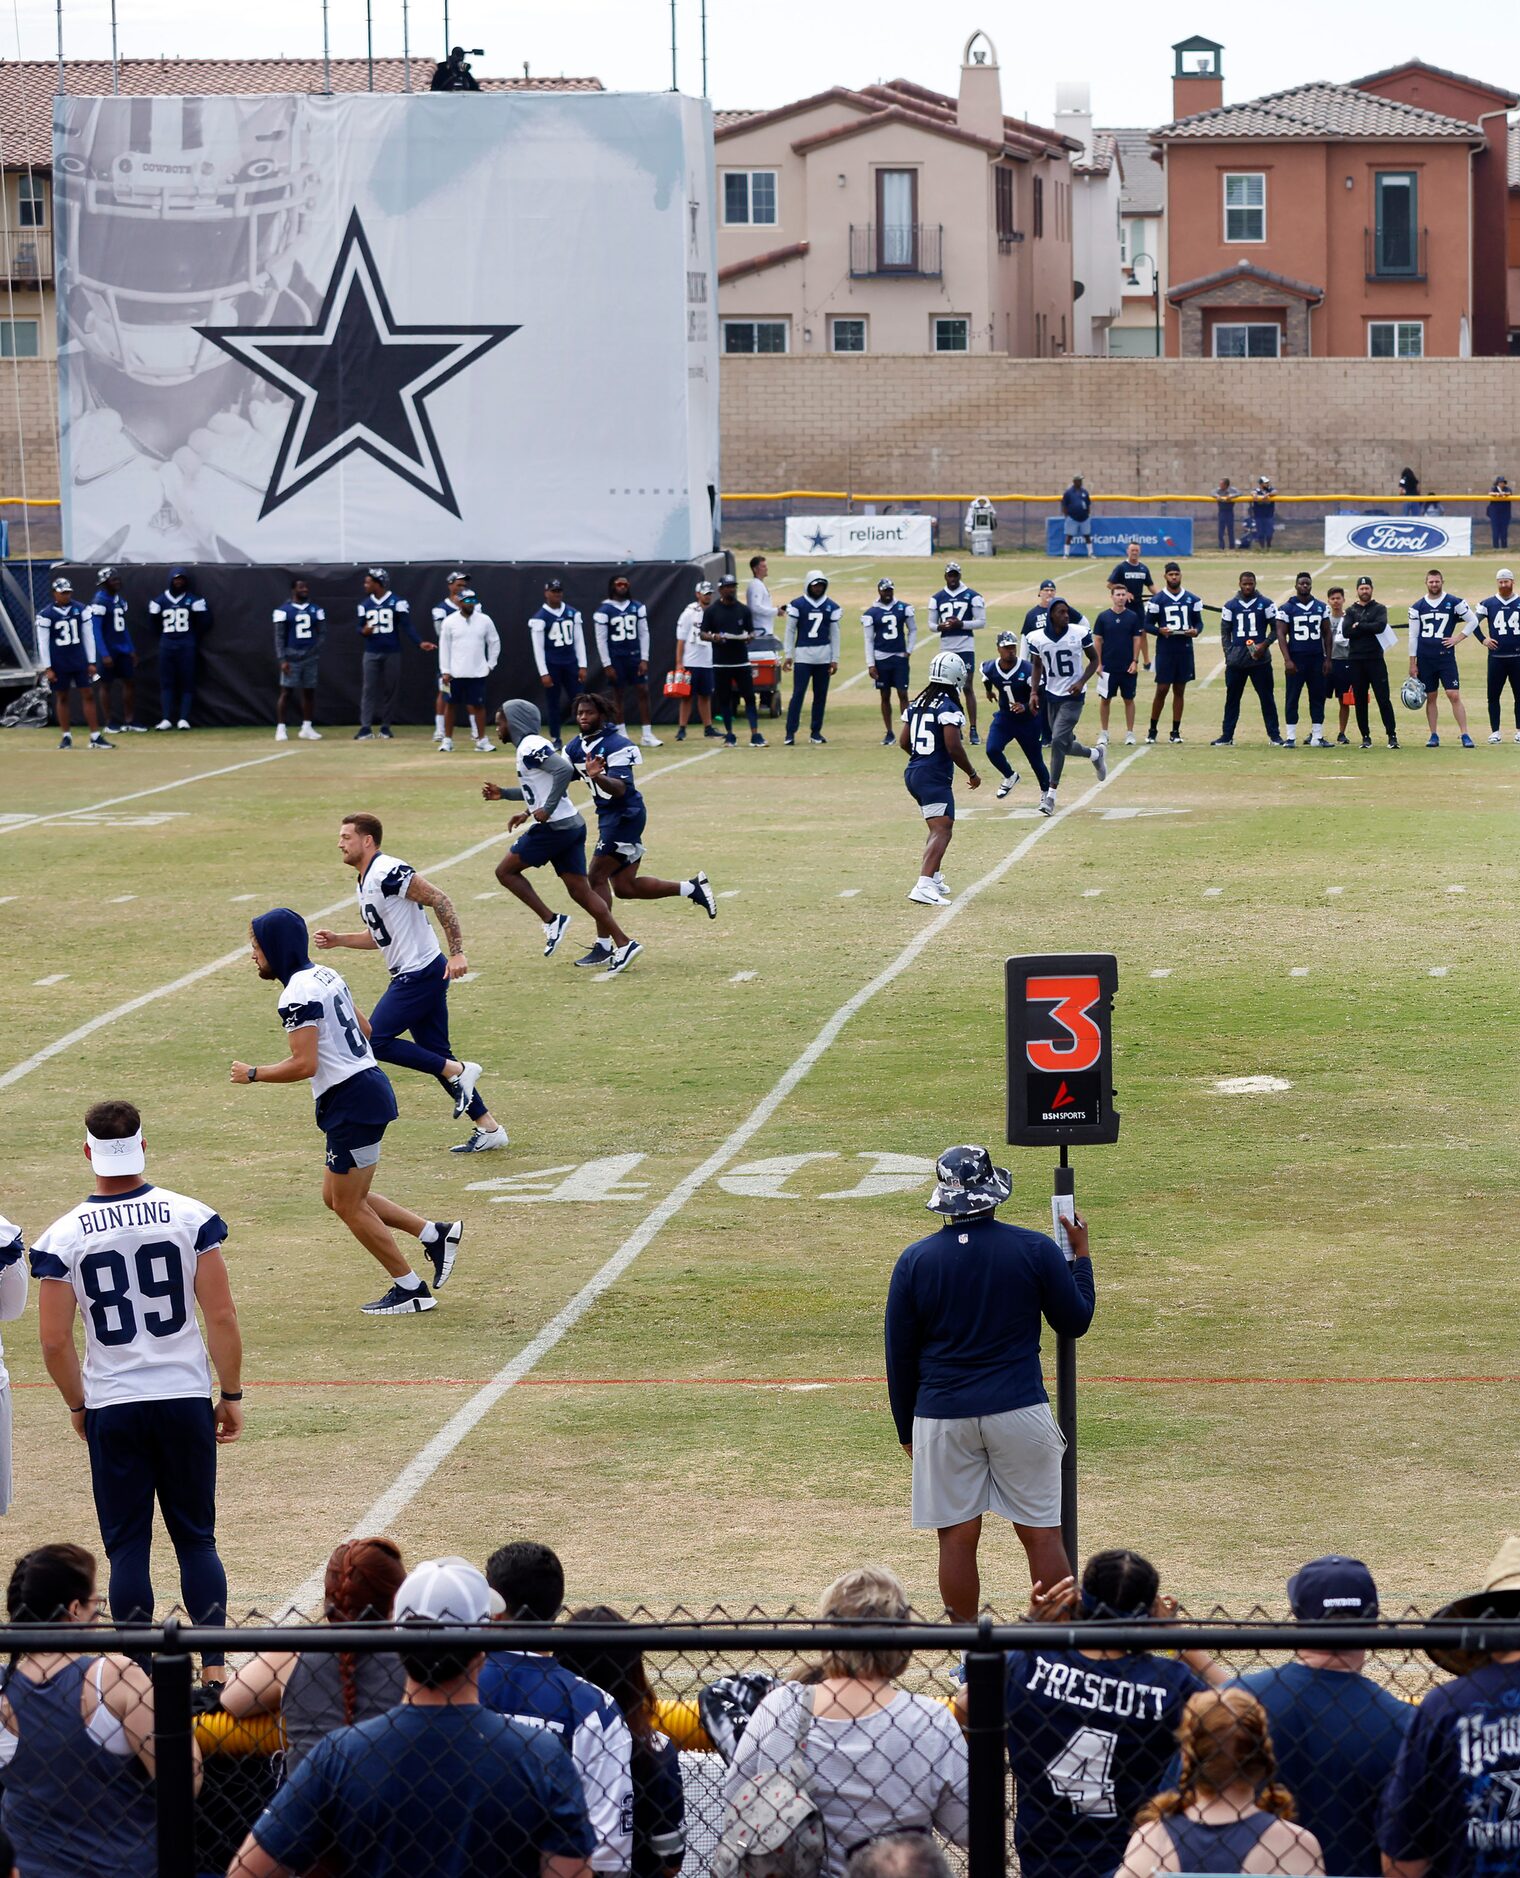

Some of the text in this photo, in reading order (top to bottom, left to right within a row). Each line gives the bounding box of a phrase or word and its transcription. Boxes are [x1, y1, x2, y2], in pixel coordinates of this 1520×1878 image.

[850, 526, 904, 541] reliant
[1117, 533, 1158, 544] Airlines
[1367, 525, 1429, 550] Ford
[113, 607, 125, 632] 6
[162, 607, 190, 633] 28
[295, 615, 312, 639] 2
[366, 608, 394, 634] 29
[610, 614, 638, 642] 39
[808, 613, 823, 638] 7
[882, 615, 898, 641] 3
[1163, 605, 1190, 631] 51
[1236, 612, 1258, 637] 11
[1293, 615, 1321, 641] 53
[1420, 612, 1450, 638] 57
[1492, 611, 1520, 636] 44
[55, 619, 81, 647] 31
[548, 620, 575, 647] 40
[1043, 649, 1075, 677] 16
[361, 903, 392, 948] 9
[333, 987, 369, 1059] 8
[1026, 974, 1101, 1073] 3
[1042, 1111, 1086, 1120] BSN SPORTS
[463, 1151, 933, 1203] 40
[78, 1201, 171, 1236] BUNTING
[79, 1240, 187, 1347] 89
[1026, 1655, 1168, 1721] PRESCOTT
[1045, 1725, 1118, 1819] 4
